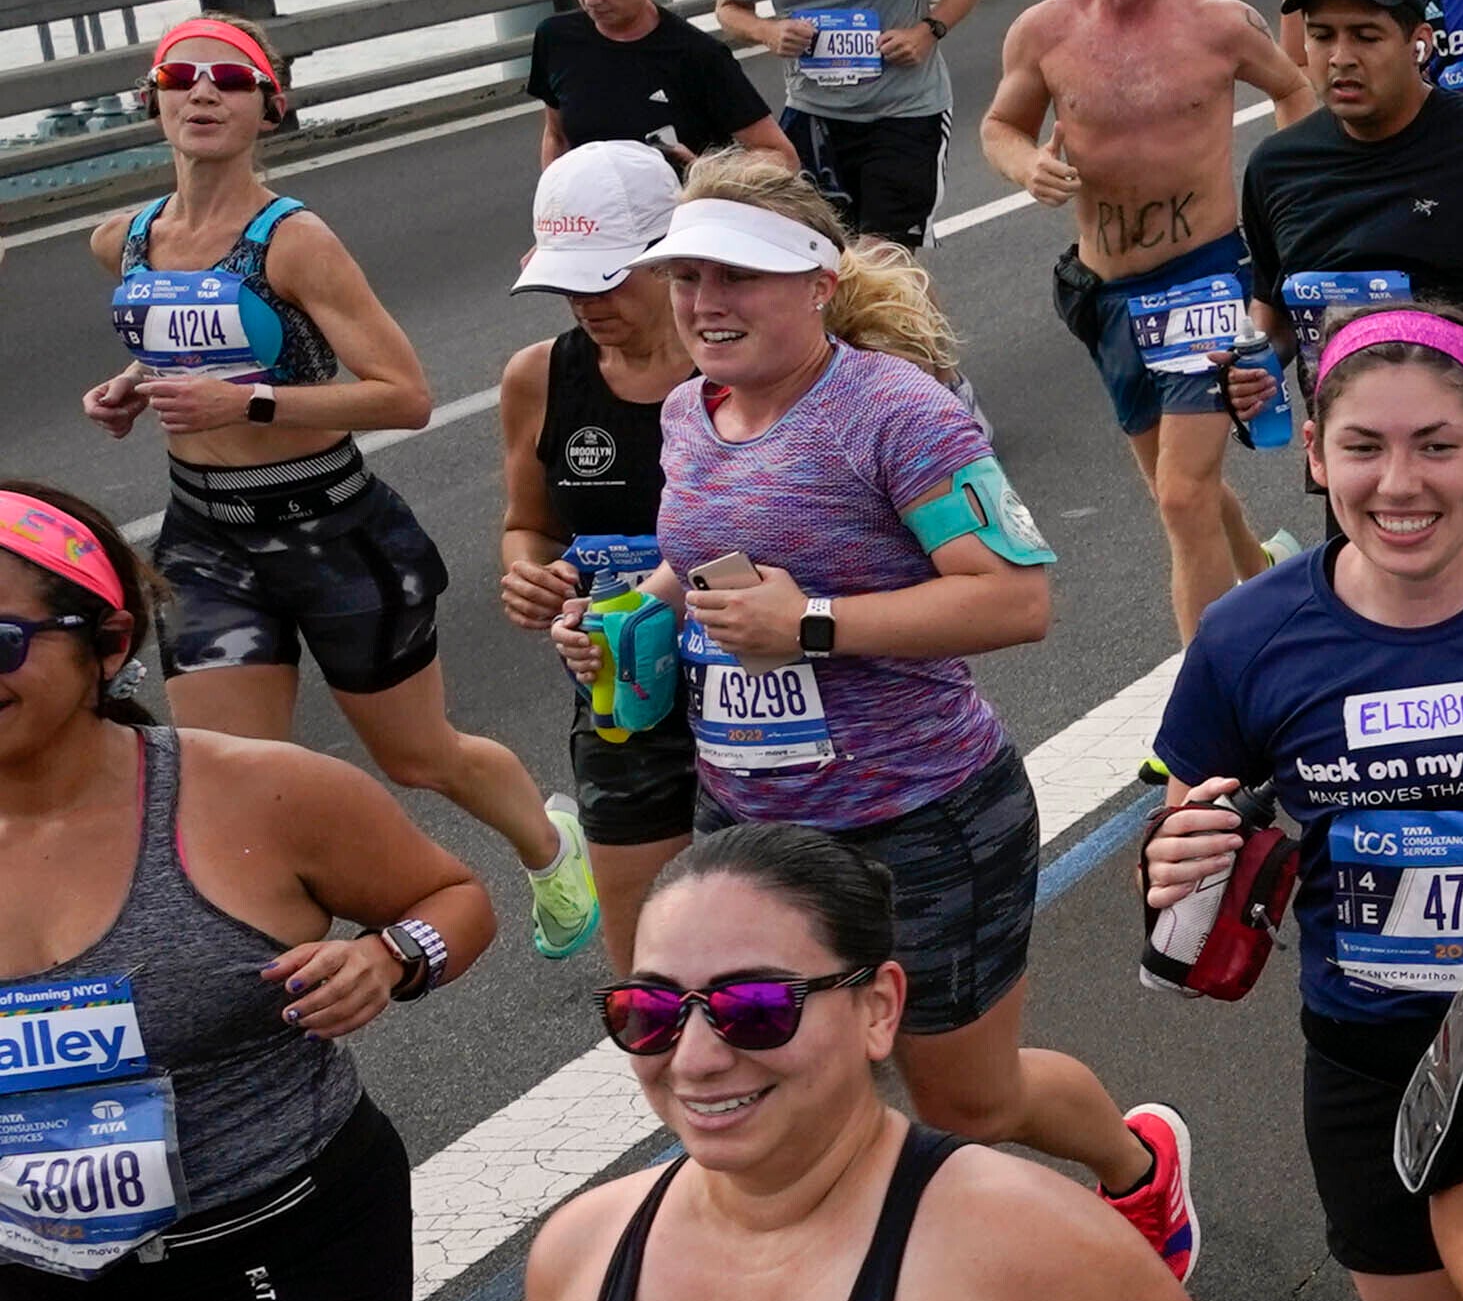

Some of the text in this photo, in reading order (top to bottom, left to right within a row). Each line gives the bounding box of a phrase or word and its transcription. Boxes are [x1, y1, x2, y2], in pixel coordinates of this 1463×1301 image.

[828, 31, 875, 57] 43506
[1294, 282, 1321, 300] tcs
[168, 309, 227, 348] 41214
[1183, 304, 1239, 341] 47757
[570, 447, 613, 458] BROOKLYN
[579, 457, 600, 467] HALF
[576, 547, 610, 566] tcs
[719, 668, 808, 719] 43298
[1297, 754, 1361, 784] back
[1368, 757, 1410, 780] on
[1308, 788, 1350, 807] MAKE
[1351, 785, 1424, 807] MOVES
[1352, 825, 1398, 856] tcs
[1402, 827, 1433, 838] TATA
[1402, 846, 1448, 858] SERVICES
[1359, 873, 1377, 891] 4
[1362, 904, 1378, 925] E
[0, 983, 108, 1006] of Running NYC!
[88, 1119, 128, 1135] TATA
[16, 1148, 146, 1215] 58018
